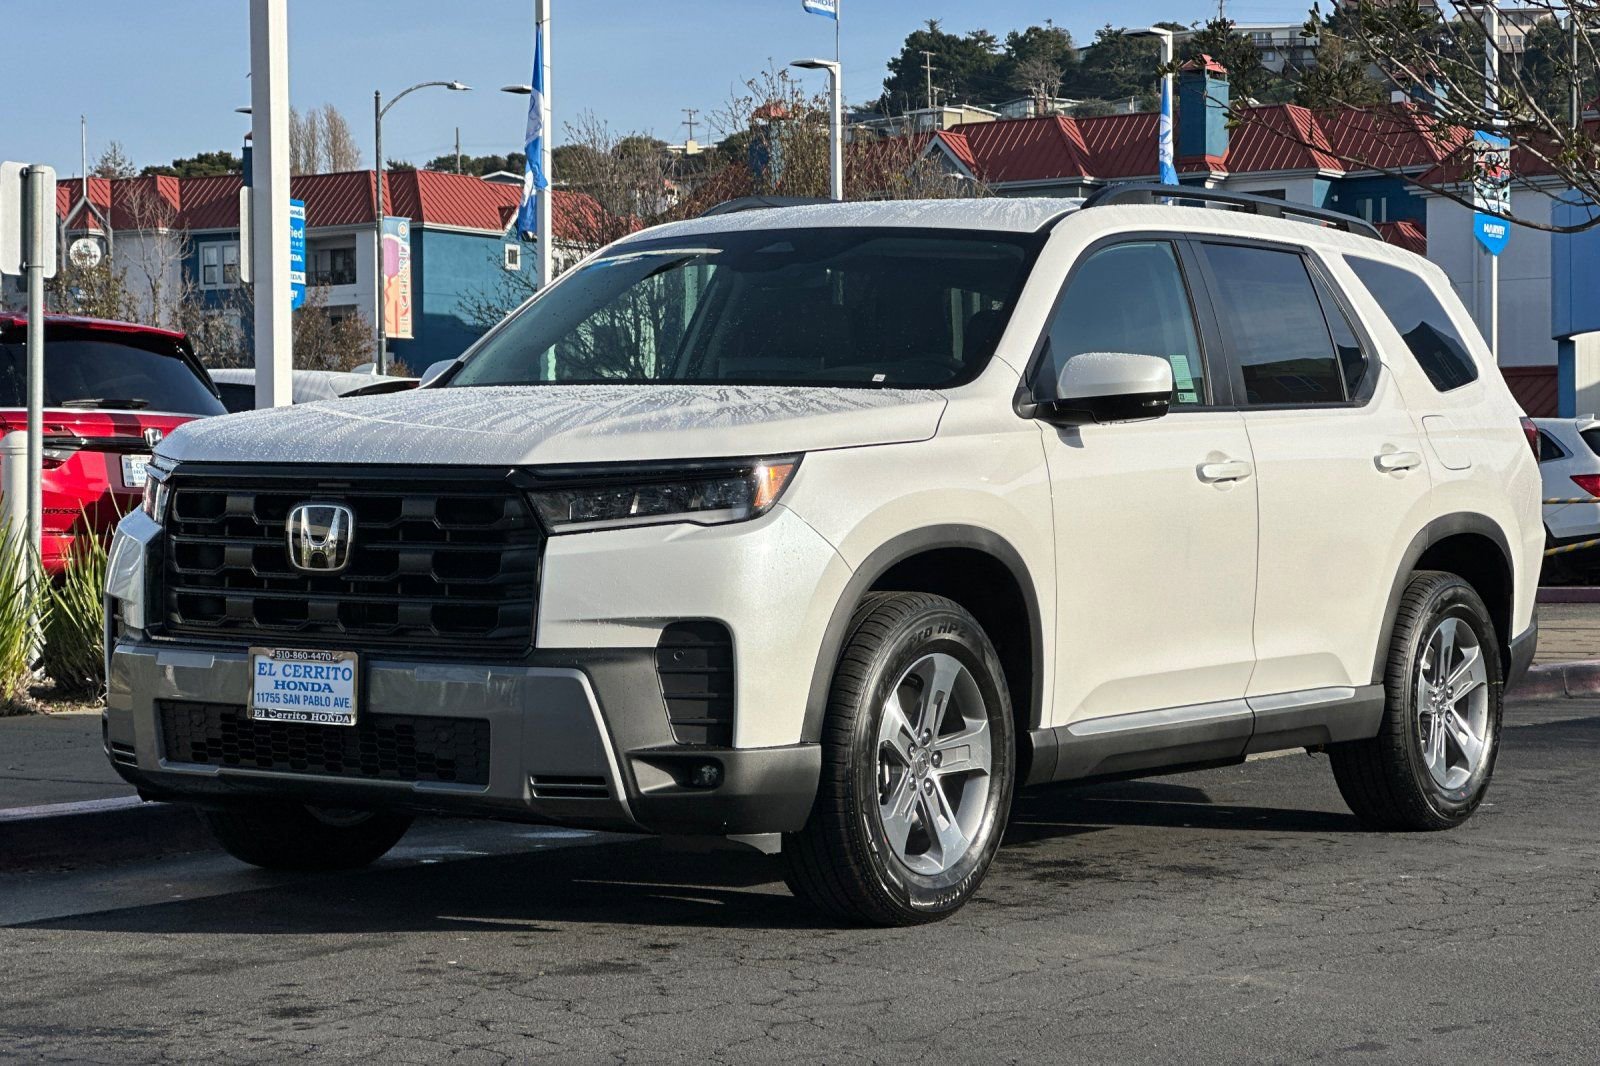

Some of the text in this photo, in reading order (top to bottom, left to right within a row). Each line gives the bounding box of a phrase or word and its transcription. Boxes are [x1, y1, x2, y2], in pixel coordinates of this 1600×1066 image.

[275, 651, 331, 660] 510-860-4470
[257, 662, 352, 681] EL CERRITO
[274, 680, 334, 693] HONDA
[256, 692, 352, 708] 11755 SAN PABLO AVE.
[254, 709, 351, 723] El Cerrito HONDA
